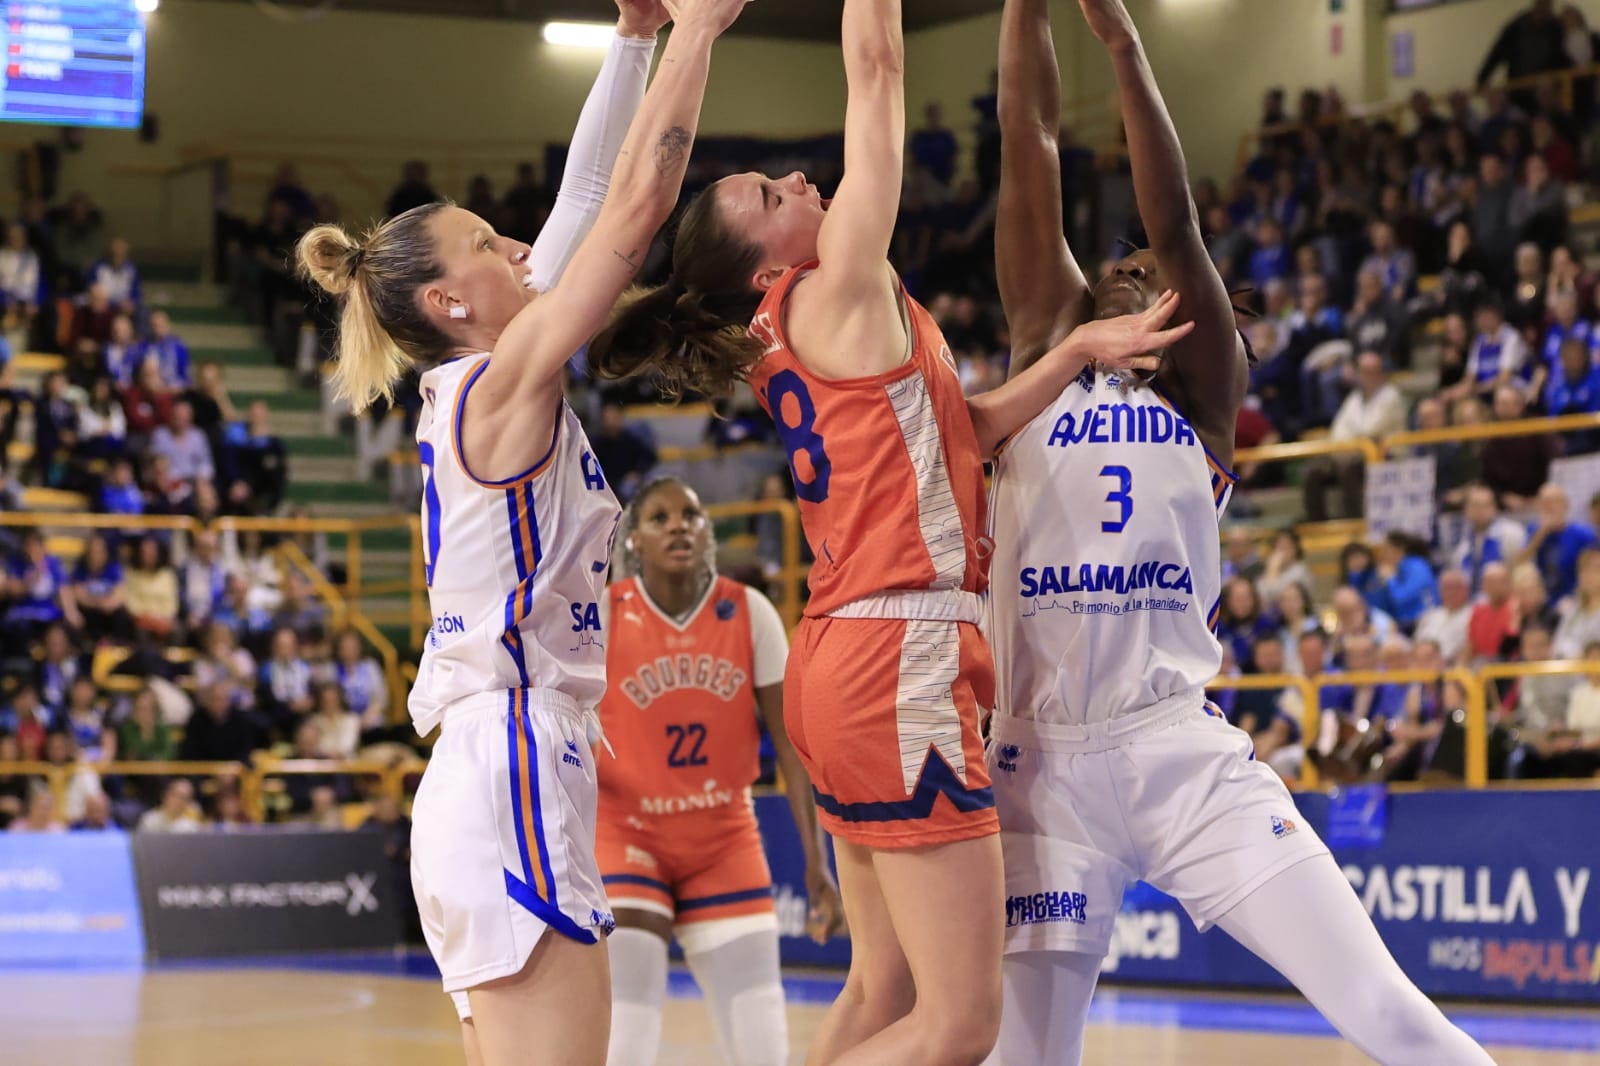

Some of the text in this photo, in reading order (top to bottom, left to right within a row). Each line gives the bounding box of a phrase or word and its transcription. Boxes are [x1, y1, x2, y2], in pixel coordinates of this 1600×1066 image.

[766, 368, 831, 504] 8
[1048, 403, 1195, 447] AVENIDA
[1099, 465, 1133, 533] 3
[1020, 561, 1193, 597] SALAMANCA
[619, 653, 747, 710] BOURGES
[666, 722, 709, 768] 22
[157, 883, 225, 909] MAX
[1014, 891, 1087, 911] RICHARD
[1021, 904, 1086, 921] HUERTA
[1341, 864, 1591, 938] CASTILLA Y
[1428, 937, 1482, 971] NOS
